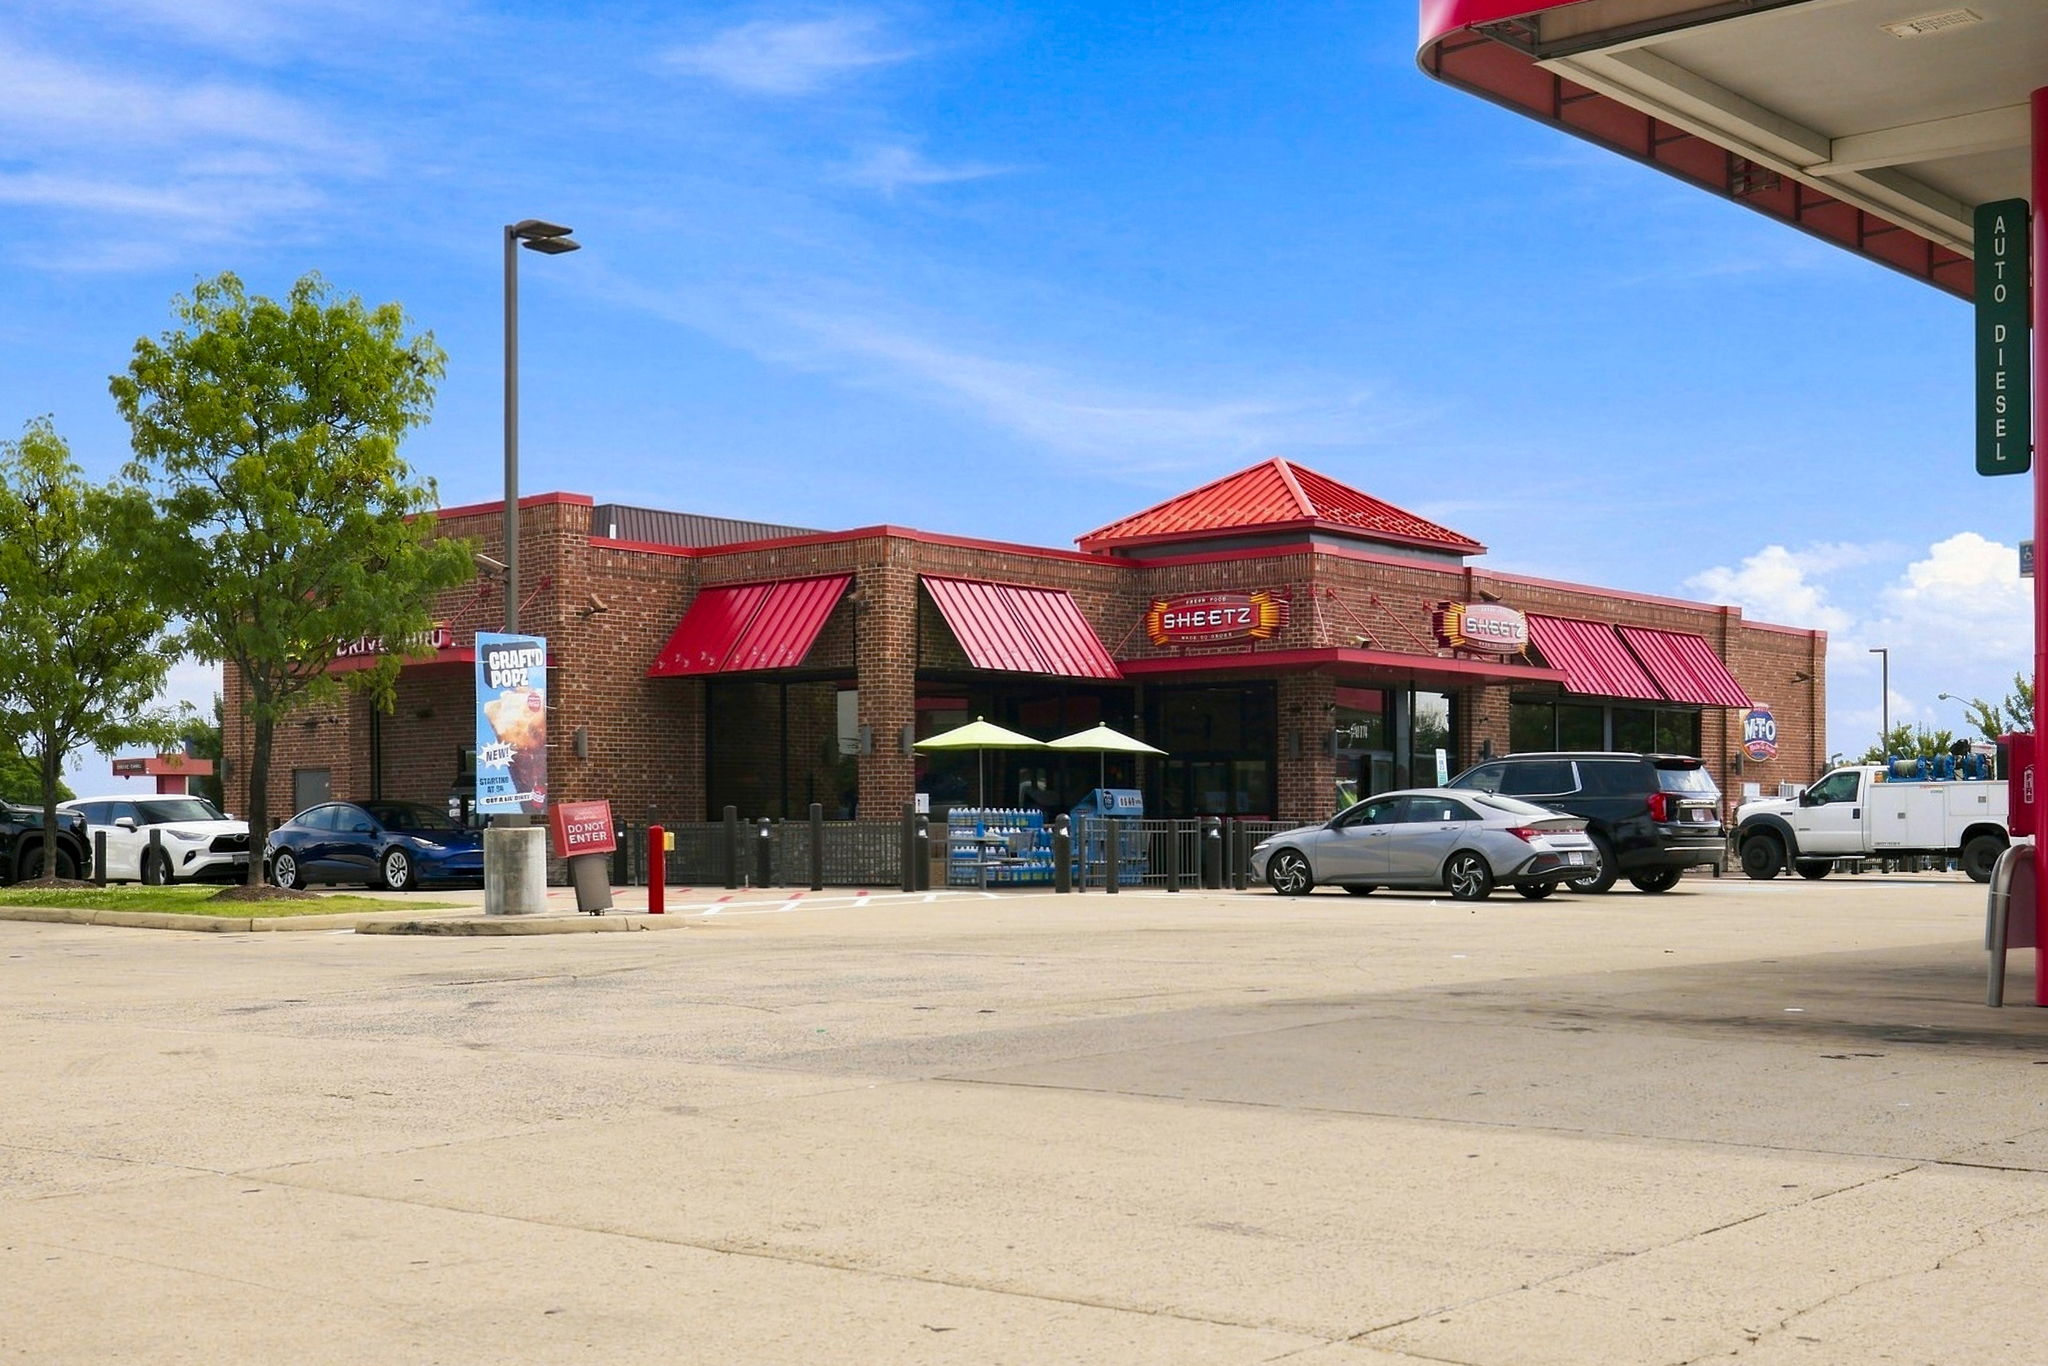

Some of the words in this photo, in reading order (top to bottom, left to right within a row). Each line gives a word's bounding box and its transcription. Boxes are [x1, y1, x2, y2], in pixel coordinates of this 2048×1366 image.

[1994, 215, 2007, 303] AUTO
[1994, 324, 2007, 461] DIESEL
[1164, 608, 1250, 629] SHEETZ
[1466, 618, 1521, 639] SHEETZ
[489, 649, 544, 670] CRAFT'D
[490, 668, 529, 689] POPZ
[485, 747, 510, 762] NEW!
[479, 776, 509, 786] STARTING
[567, 824, 583, 834] DO
[584, 821, 605, 832] NOT
[569, 831, 608, 844] ENTER
